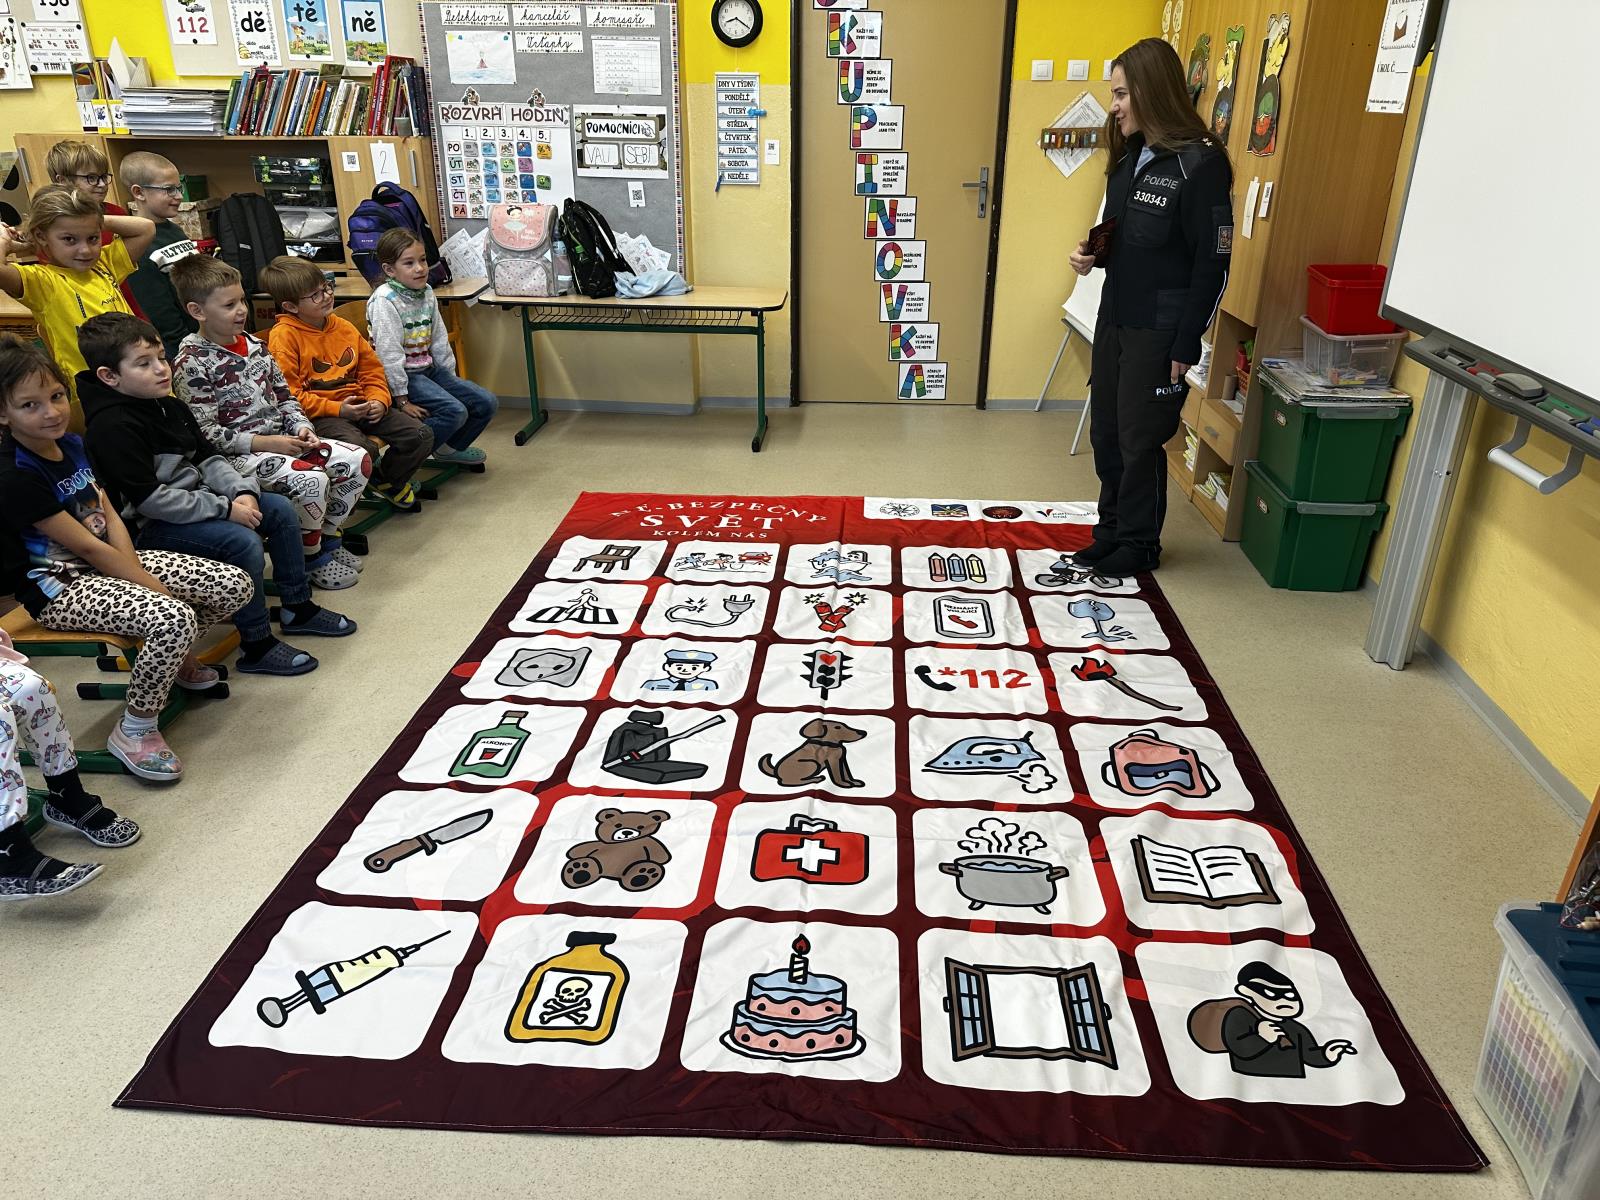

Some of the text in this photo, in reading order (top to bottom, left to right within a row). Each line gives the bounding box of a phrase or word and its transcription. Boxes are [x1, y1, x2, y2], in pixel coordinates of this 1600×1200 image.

[294, 0, 318, 22] tě
[444, 8, 646, 24] Detektivní kancelář komisaře
[176, 16, 209, 33] 112
[241, 10, 266, 32] dě
[352, 10, 376, 32] ně
[829, 13, 858, 55] K
[526, 36, 574, 50] Vrťapky
[840, 60, 864, 102] U
[441, 107, 564, 122] ROZVRH HODIN
[728, 106, 746, 114] ÚTERÝ
[586, 121, 640, 134] POMOCNÍCI
[852, 106, 877, 148] P
[725, 132, 750, 140] ČTVRTEK
[448, 143, 460, 152] PO
[379, 150, 389, 174] 2
[450, 156, 462, 168] ÚT
[451, 175, 463, 184] ST
[728, 171, 749, 180] NEDĚLE
[857, 154, 878, 193] I
[1143, 175, 1178, 190] POLICIE
[453, 189, 465, 199] ČT
[1134, 191, 1167, 206] 330343
[454, 205, 466, 215] PÁ
[867, 198, 898, 237] N
[877, 242, 903, 280] O
[882, 284, 908, 320] V
[891, 324, 918, 359] K
[900, 365, 927, 398] A
[640, 514, 783, 530] SVĚT
